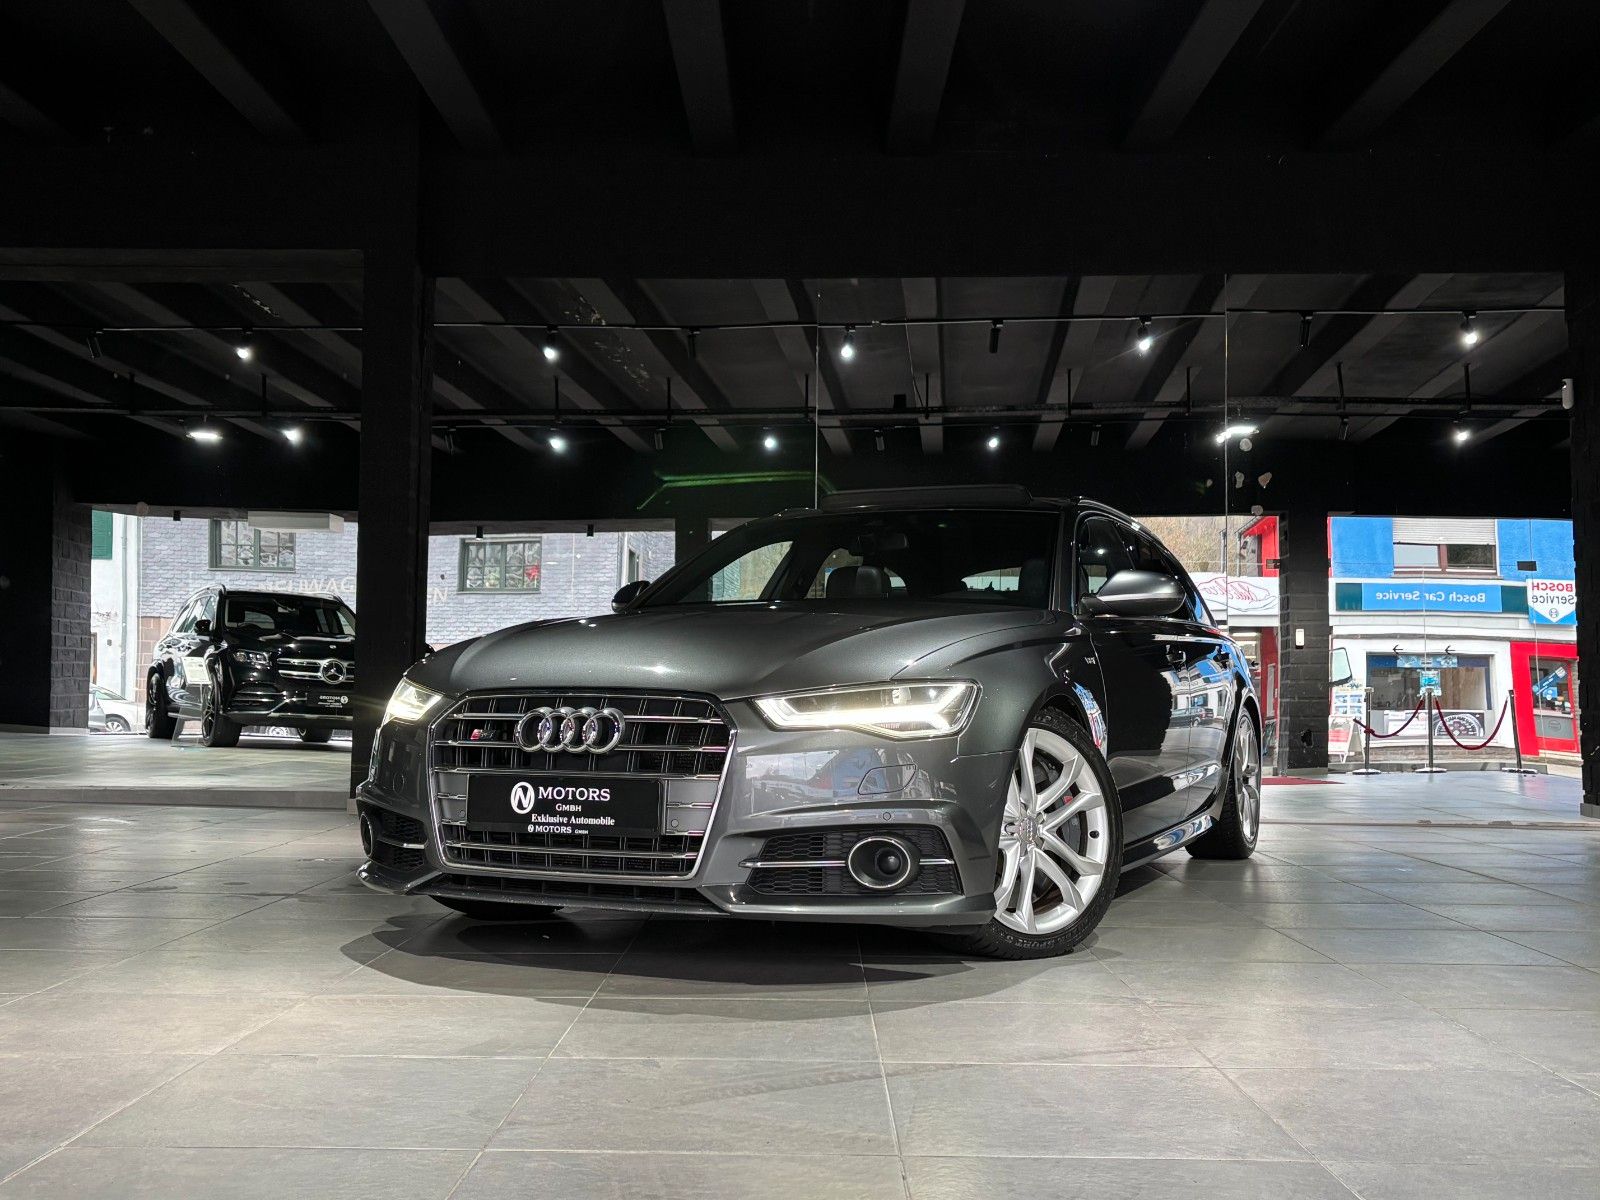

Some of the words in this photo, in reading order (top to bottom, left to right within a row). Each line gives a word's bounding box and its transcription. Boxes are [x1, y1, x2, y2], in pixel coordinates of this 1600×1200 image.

[538, 786, 611, 802] MOTORS
[555, 803, 582, 812] GMBH
[531, 813, 568, 824] Exklusive
[569, 815, 615, 826] Automobile
[535, 825, 572, 834] MOTORS
